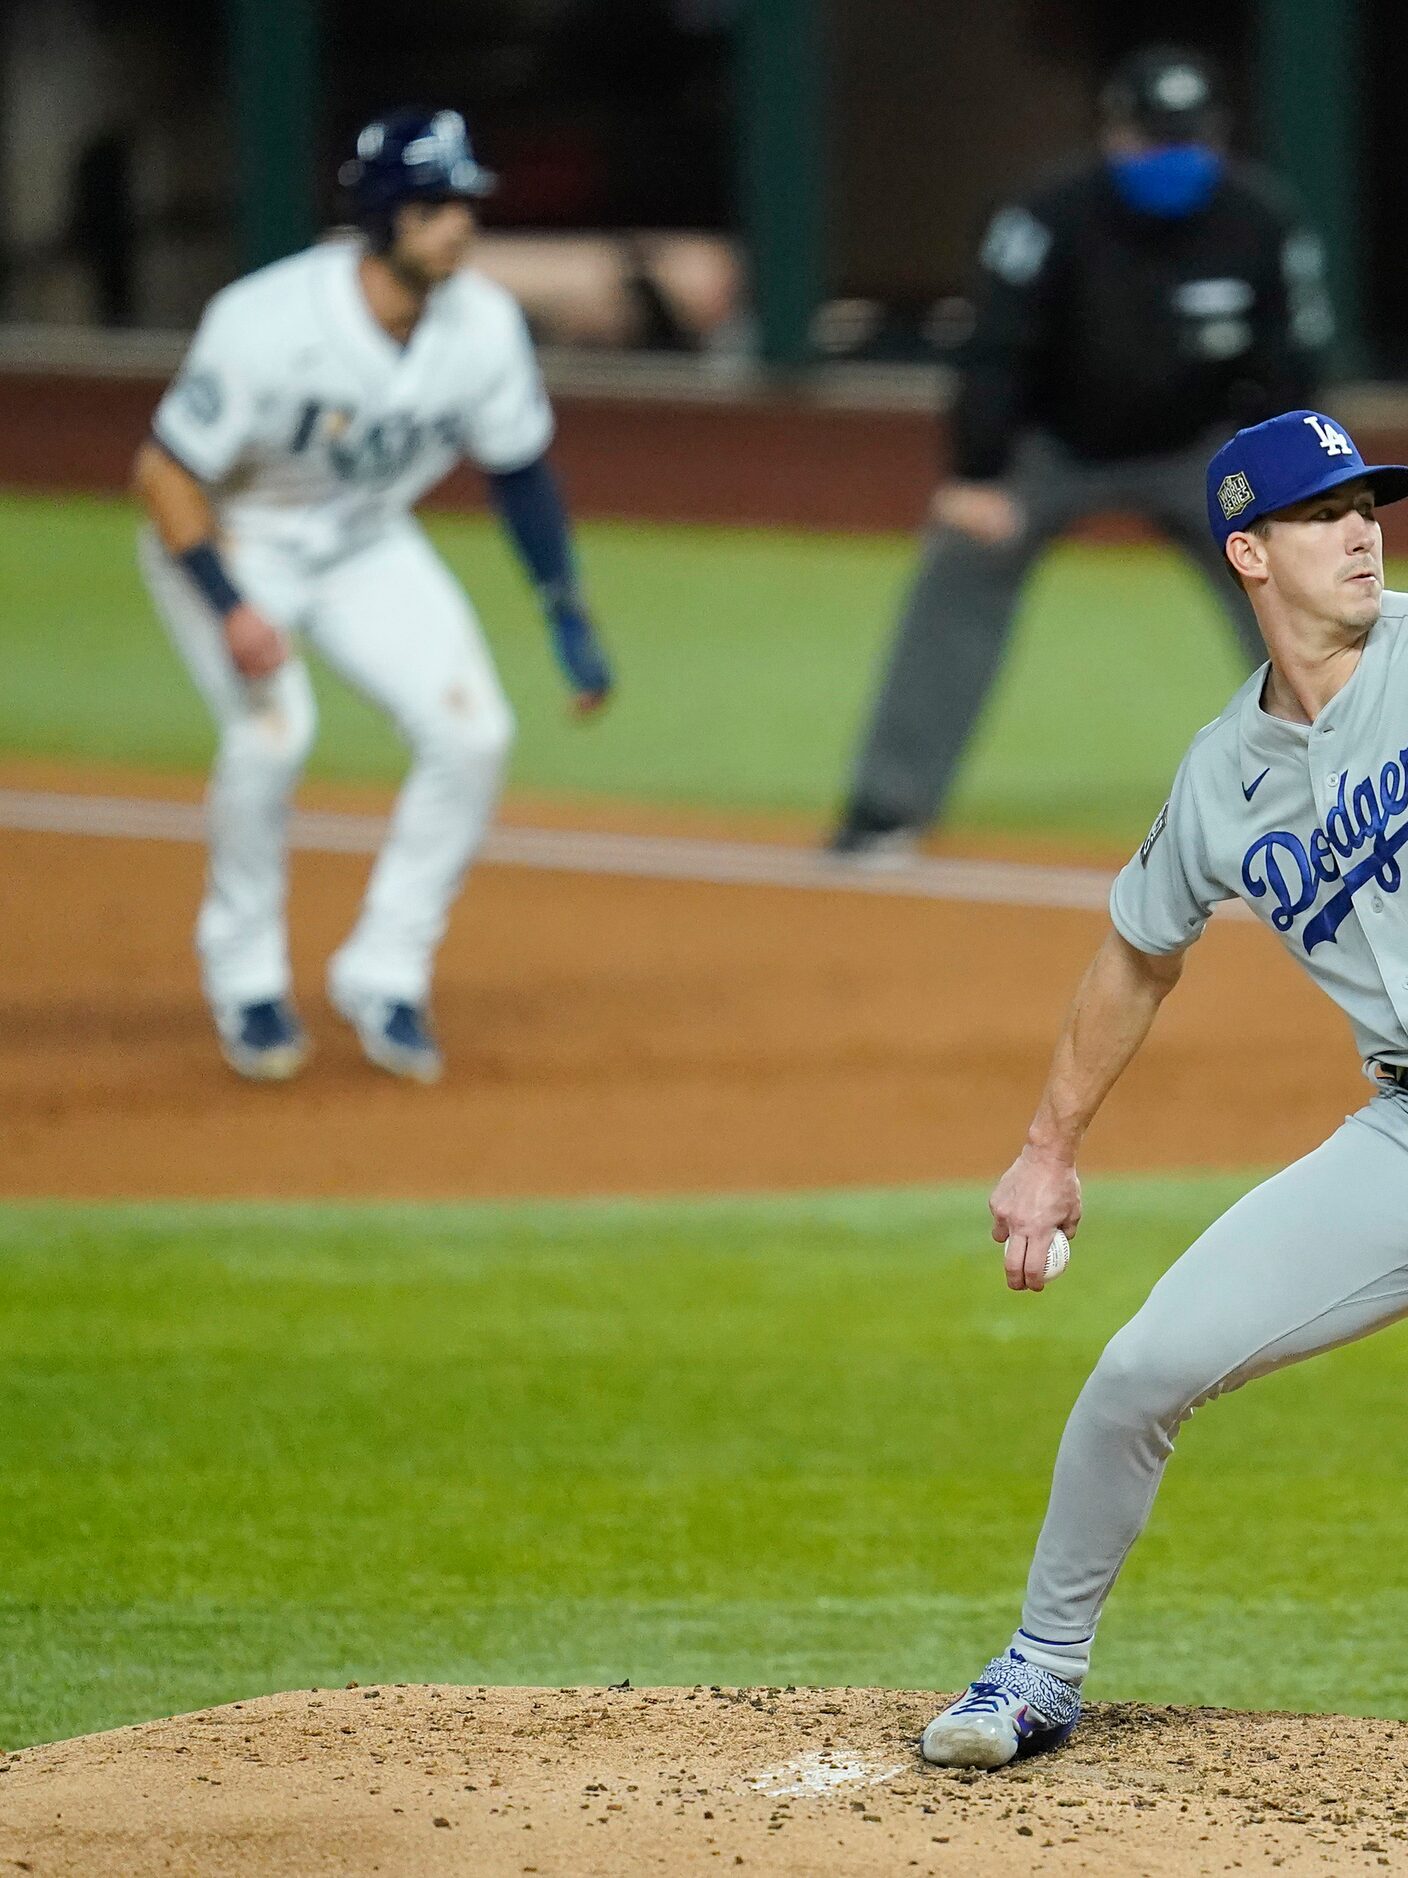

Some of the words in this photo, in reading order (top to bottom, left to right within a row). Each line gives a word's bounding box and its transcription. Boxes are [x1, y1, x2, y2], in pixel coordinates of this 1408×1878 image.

[1303, 415, 1353, 456] LA
[1219, 476, 1246, 506] WORLD
[1223, 486, 1251, 516] SERIES
